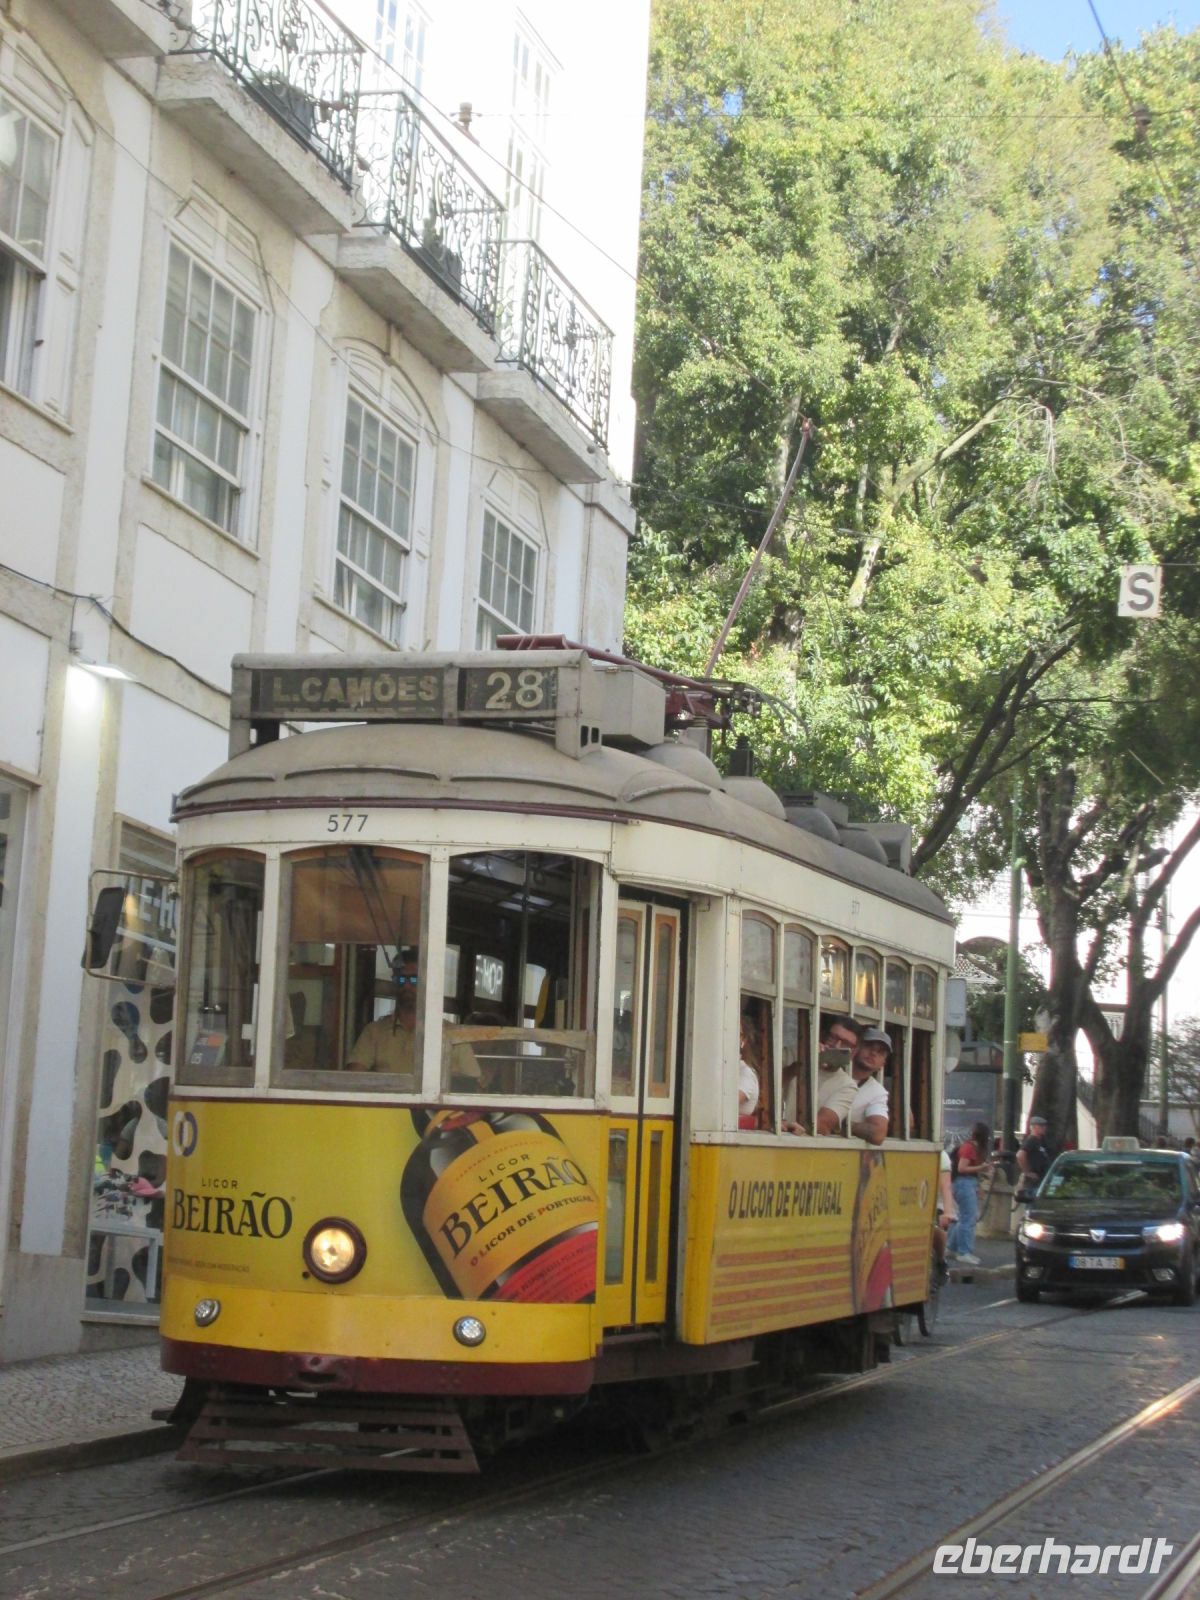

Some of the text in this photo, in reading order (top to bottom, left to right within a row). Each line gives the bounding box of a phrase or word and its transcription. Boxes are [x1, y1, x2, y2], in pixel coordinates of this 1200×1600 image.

[1128, 572, 1155, 611] S
[485, 669, 544, 710] 28
[327, 814, 368, 832] 577
[201, 1178, 239, 1189] LICOR
[478, 1153, 531, 1183] LICOR
[172, 1188, 293, 1239] BEIRÃO
[438, 1155, 588, 1260] BEIRÃO
[728, 1181, 738, 1219] O
[738, 1181, 774, 1219] LICOR
[775, 1181, 792, 1217] DE
[792, 1182, 842, 1216] PORTUGAL
[469, 1255, 479, 1267] O
[479, 1225, 517, 1258] LICOR
[517, 1212, 537, 1229] DE
